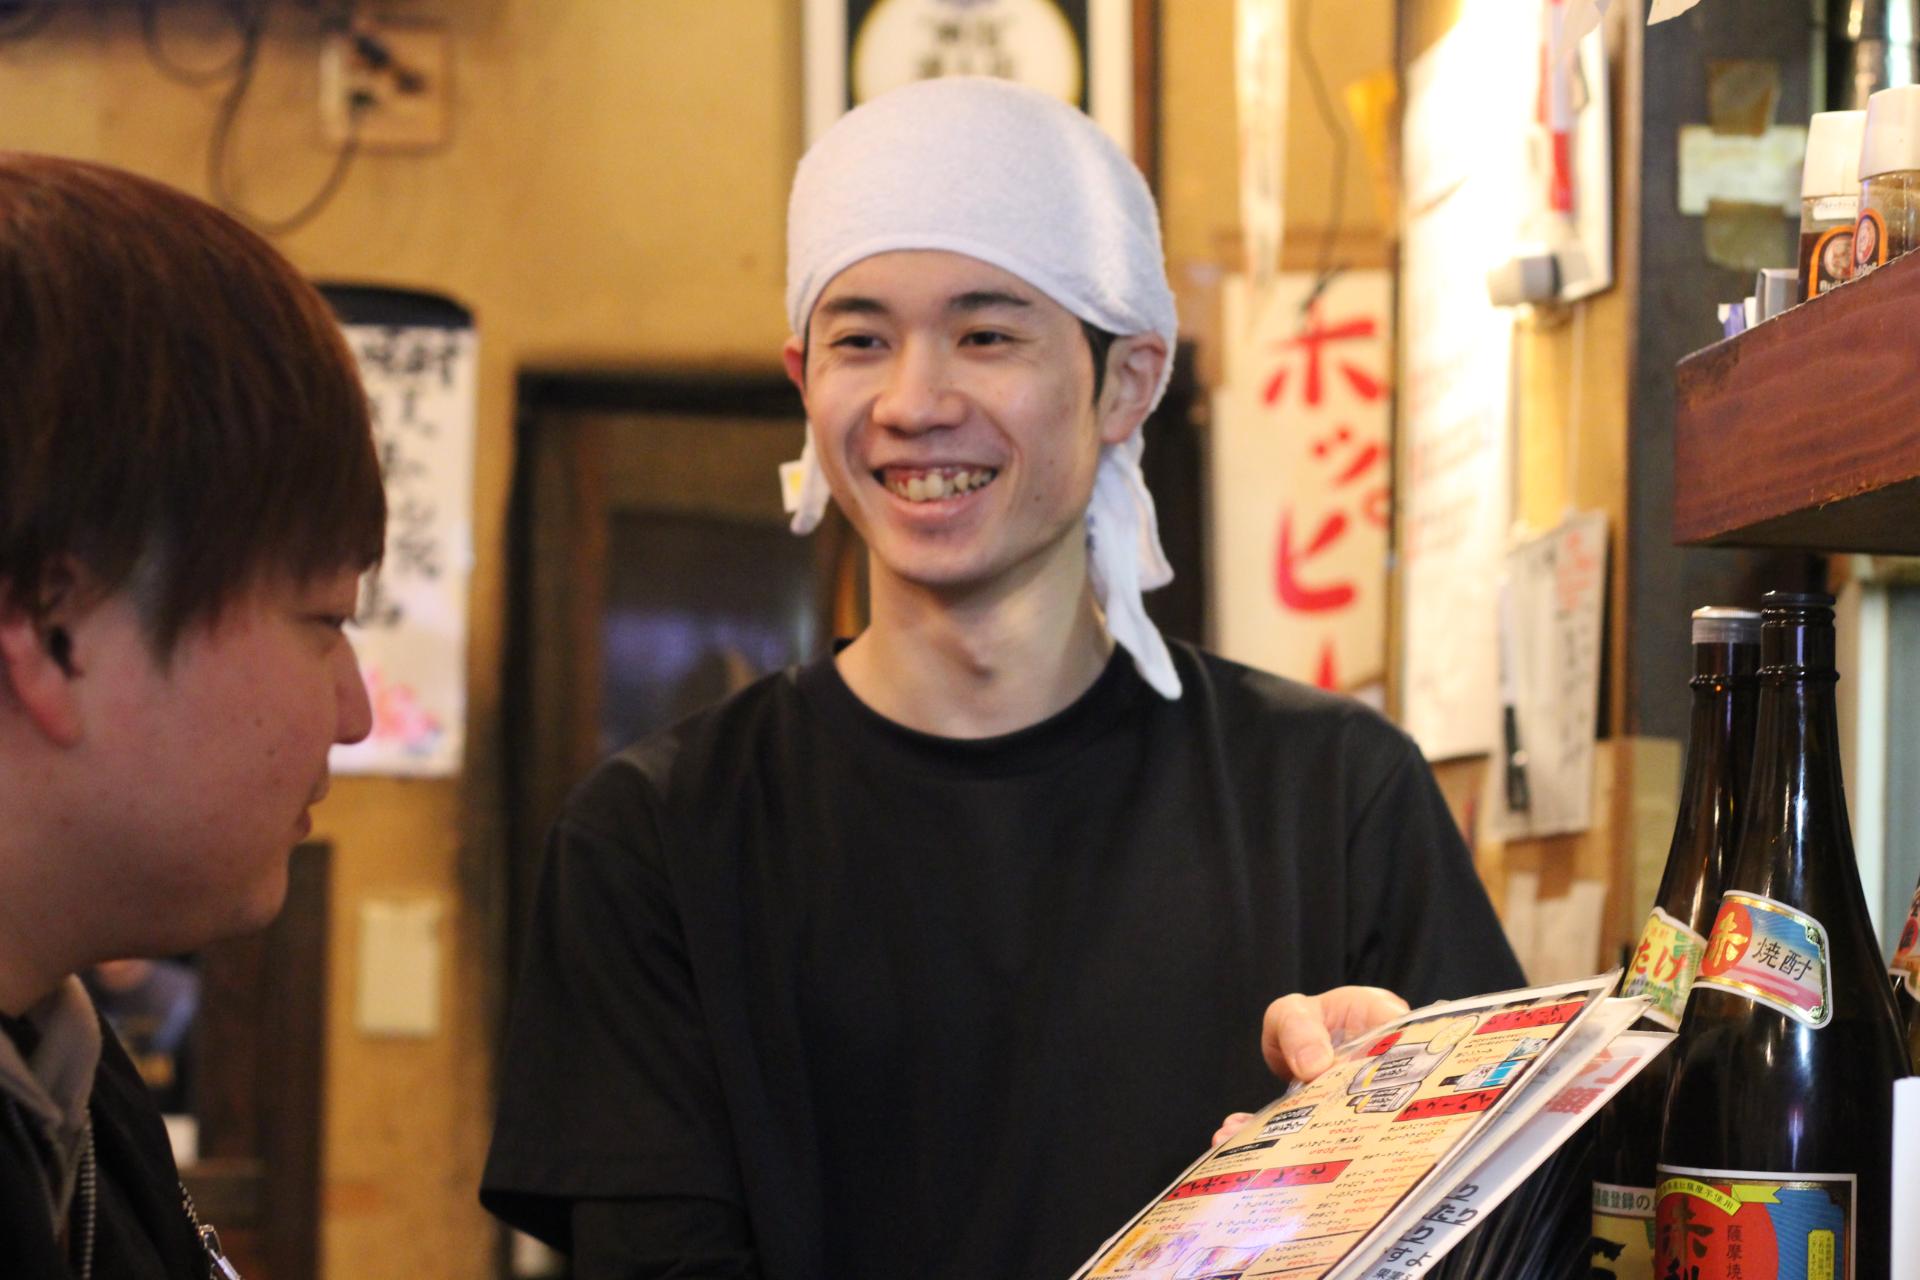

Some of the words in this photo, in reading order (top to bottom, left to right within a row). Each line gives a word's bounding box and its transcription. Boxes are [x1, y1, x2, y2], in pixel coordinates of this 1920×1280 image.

[1708, 911, 1749, 968] 赤
[1752, 937, 1812, 980] 焼酎
[1387, 1247, 1432, 1267] すよ
